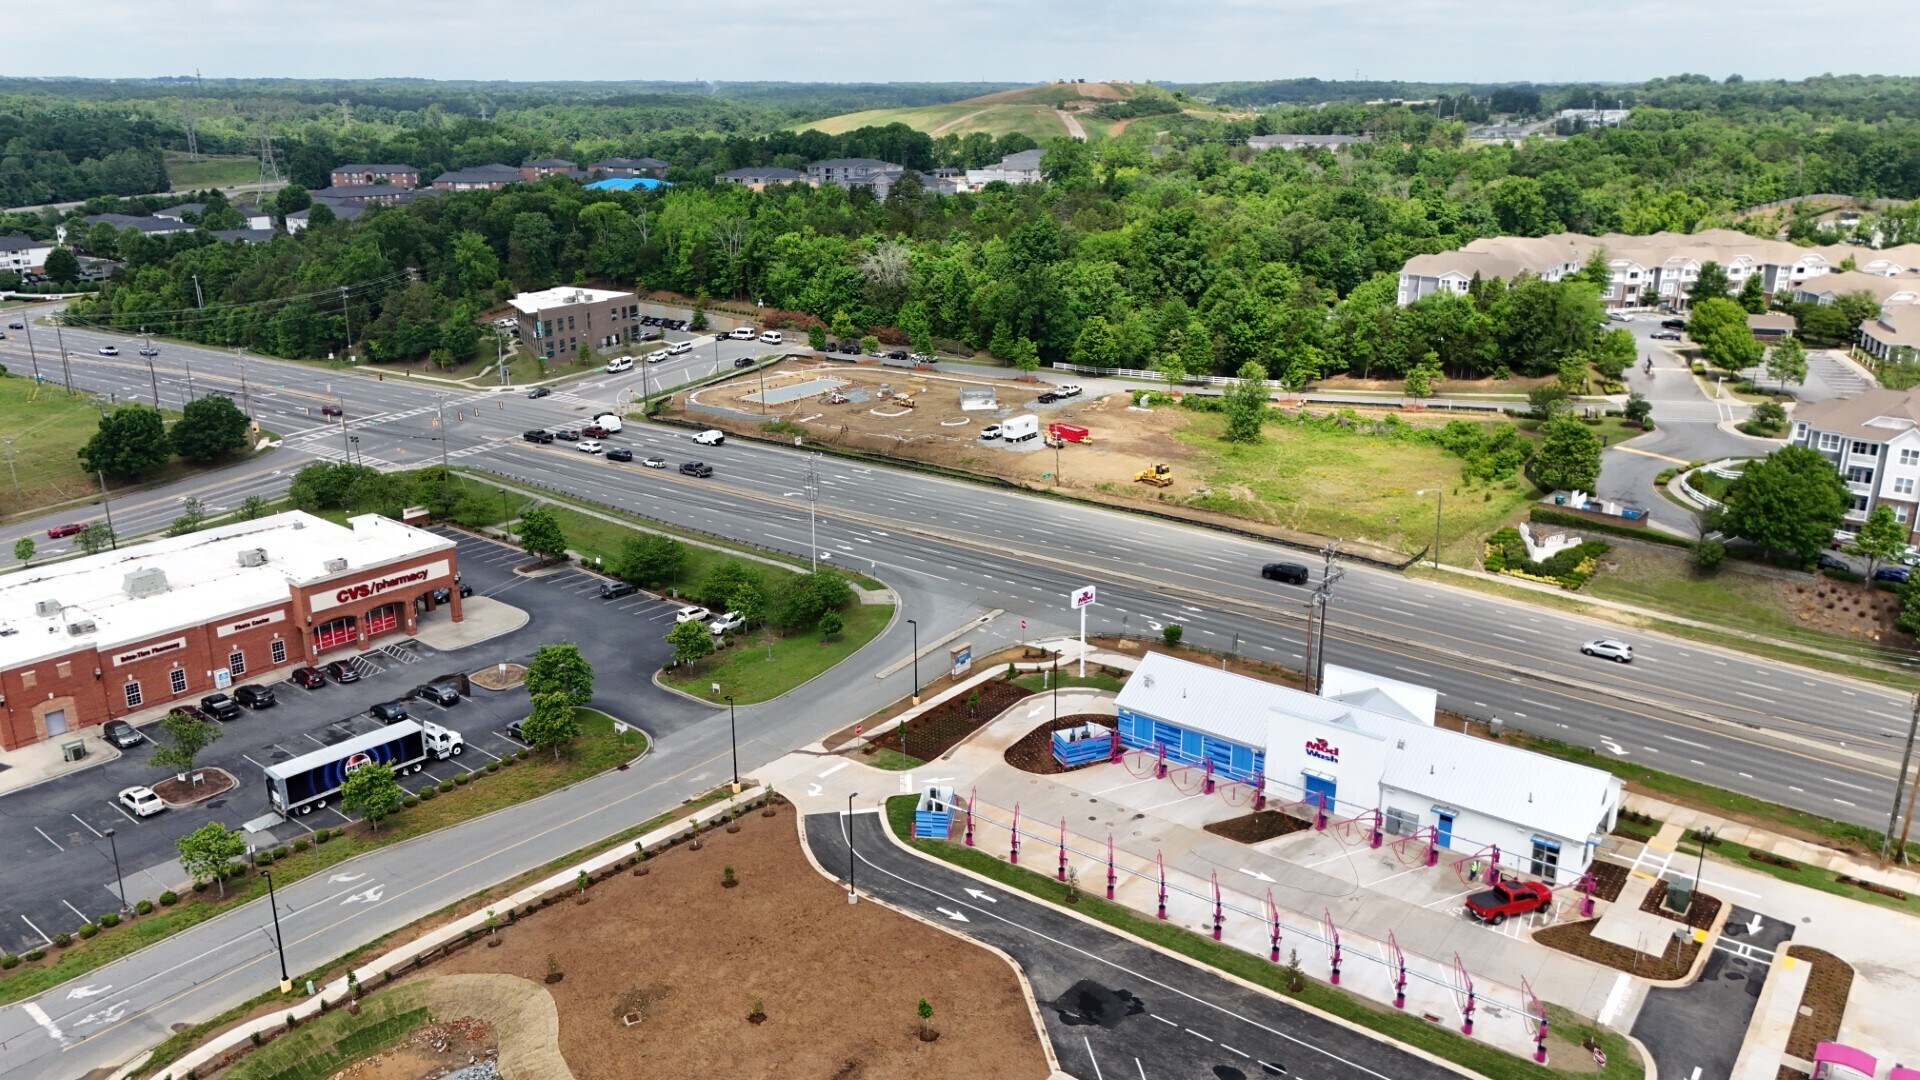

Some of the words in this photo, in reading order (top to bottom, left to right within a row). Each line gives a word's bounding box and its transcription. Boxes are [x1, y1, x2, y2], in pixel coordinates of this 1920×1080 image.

[336, 569, 428, 603] CVS/pharmacy
[1305, 739, 1339, 756] Mod
[1305, 748, 1339, 763] Wash
